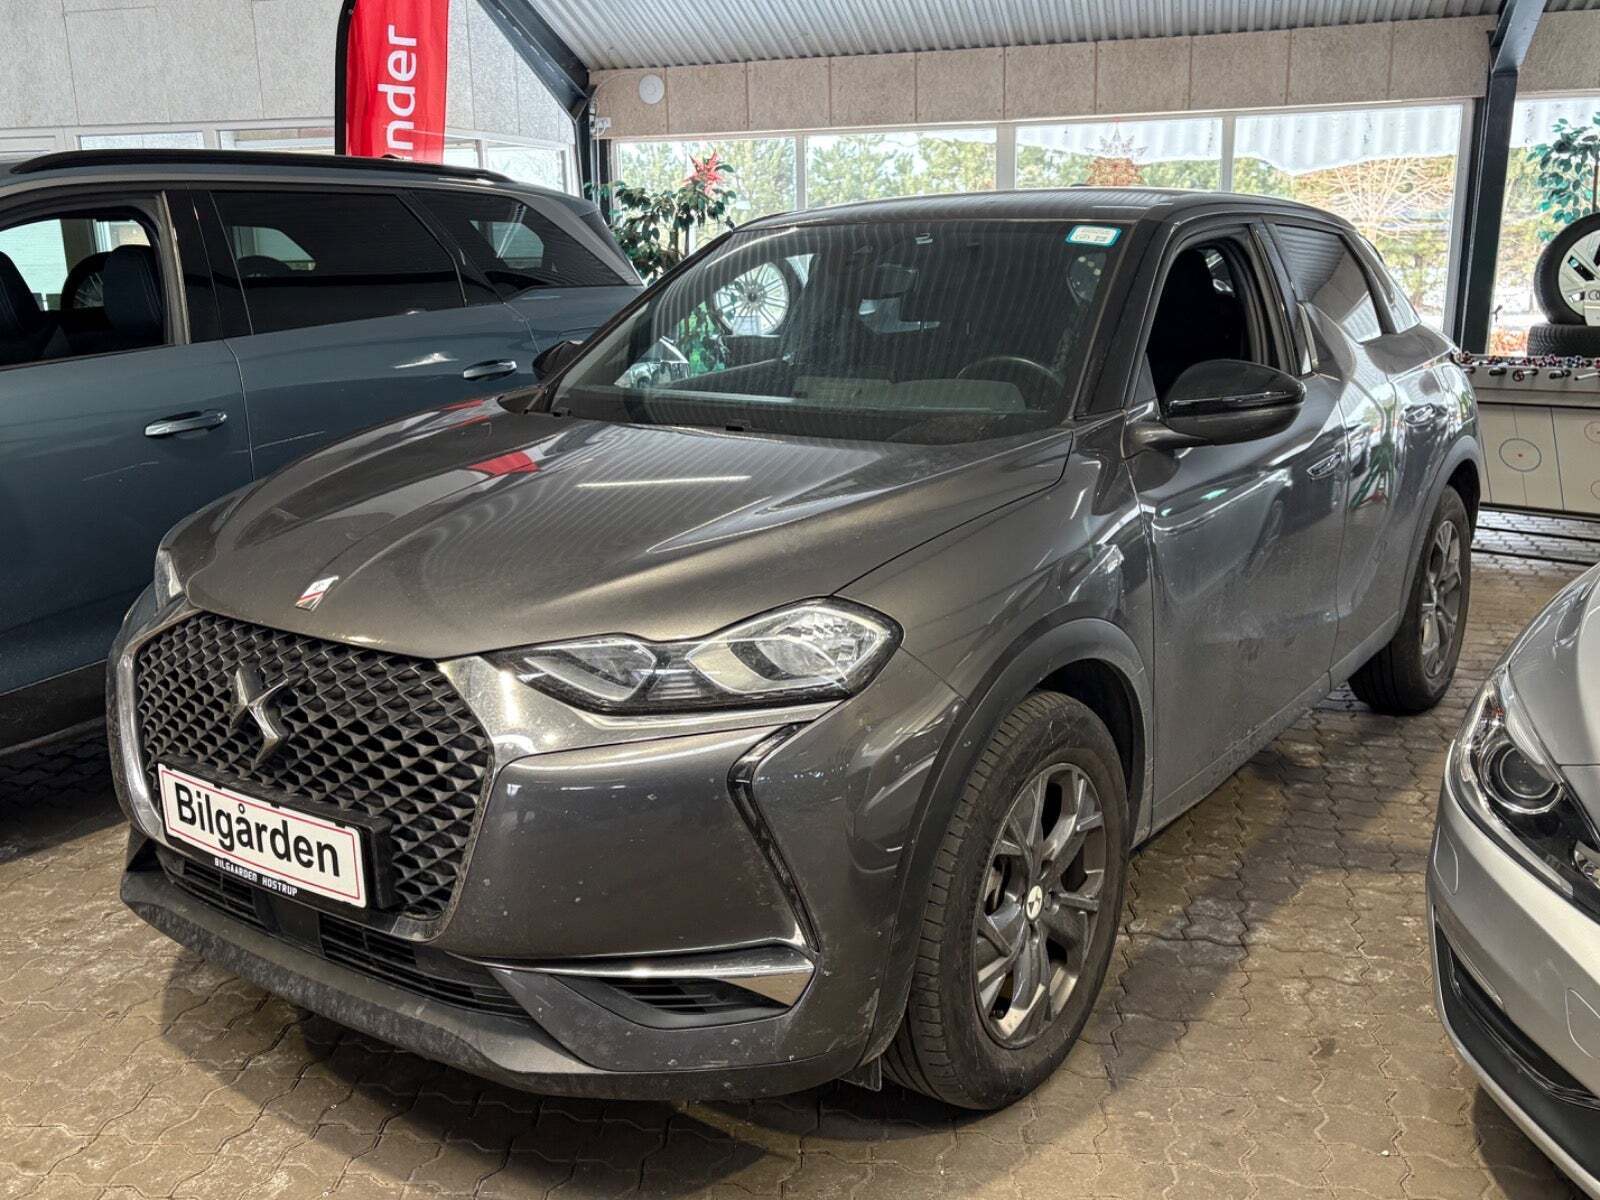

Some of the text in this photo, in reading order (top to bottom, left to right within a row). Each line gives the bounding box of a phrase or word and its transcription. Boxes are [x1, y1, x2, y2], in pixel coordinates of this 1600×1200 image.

[377, 24, 417, 160] nder
[174, 781, 341, 878] Bilgården
[214, 857, 298, 897] BILGAARDEN HOSTRUP
